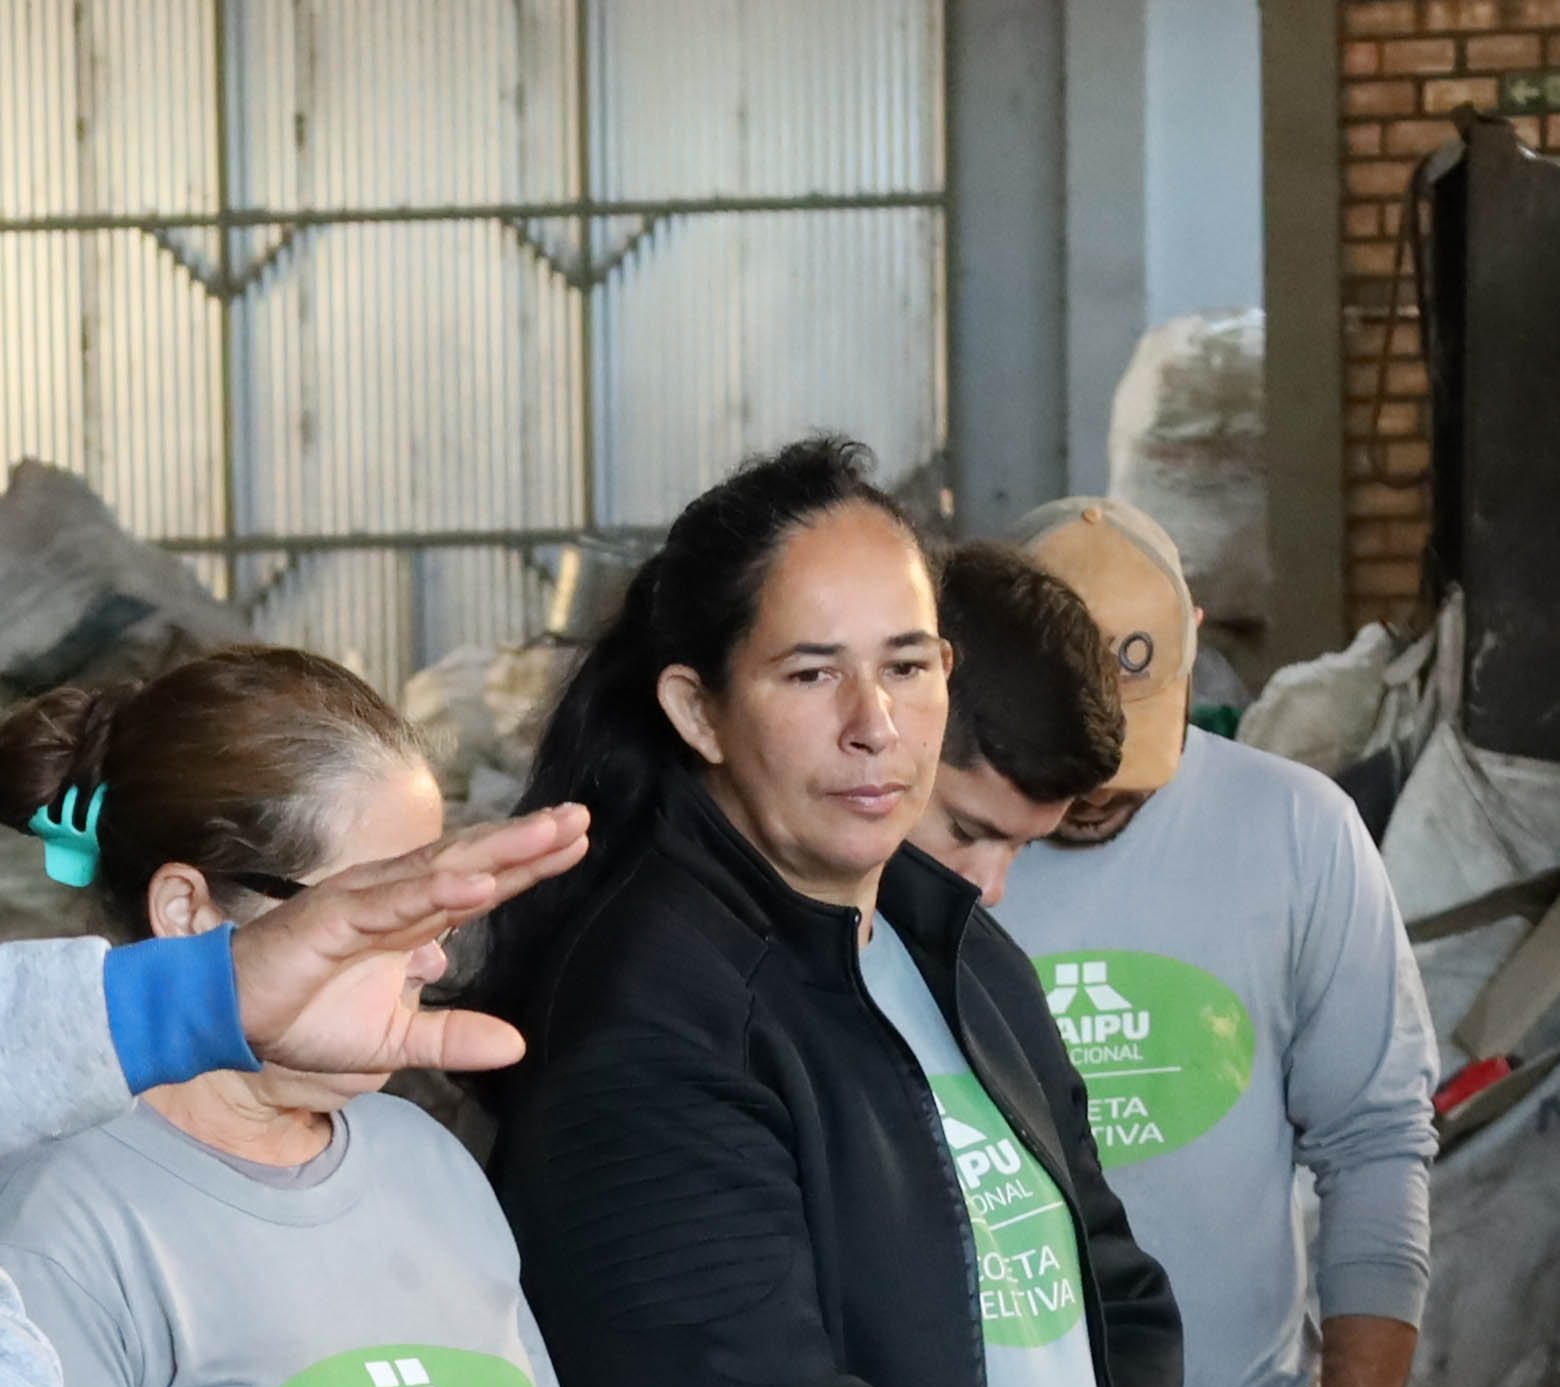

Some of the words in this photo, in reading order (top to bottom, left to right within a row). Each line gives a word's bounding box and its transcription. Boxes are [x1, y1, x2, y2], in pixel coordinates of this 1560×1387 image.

[1056, 1010, 1150, 1045] AIPU
[1069, 1043, 1144, 1065] CIONAL
[1088, 1096, 1149, 1121] ETA
[1091, 1122, 1165, 1147] TIVA
